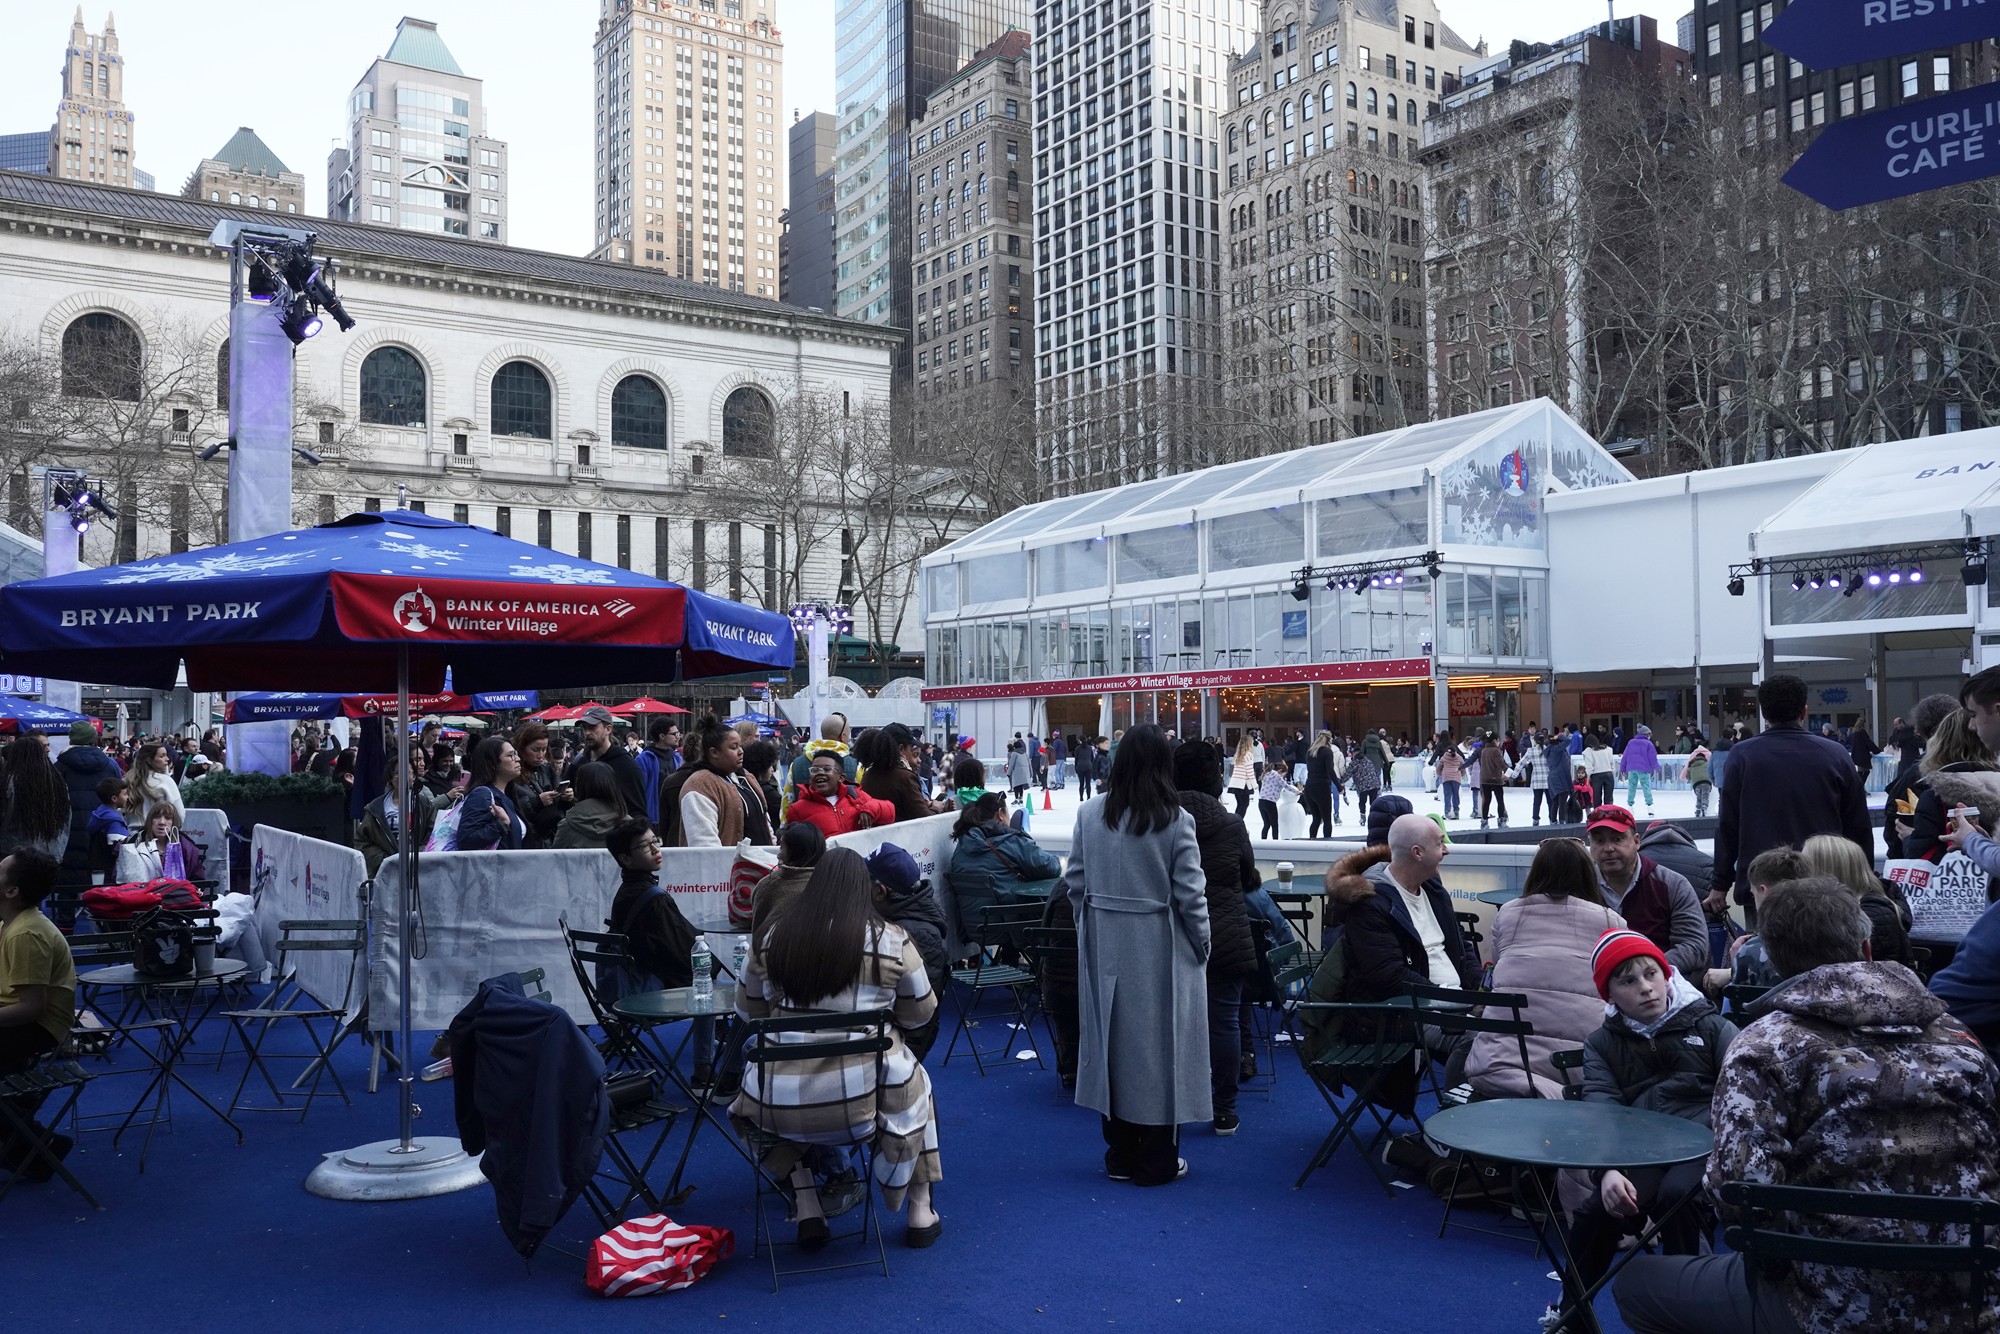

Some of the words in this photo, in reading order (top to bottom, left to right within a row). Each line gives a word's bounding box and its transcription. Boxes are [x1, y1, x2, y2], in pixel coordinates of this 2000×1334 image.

[1885, 100, 2000, 149] CURLI
[1887, 130, 1985, 178] CAFÉ
[1914, 460, 2000, 479] BAN
[60, 605, 174, 627] BRYANT
[187, 601, 262, 621] PARK
[446, 599, 494, 612] BANK
[498, 600, 521, 613] OF
[524, 601, 600, 616] AMERICA
[446, 616, 503, 631] Winter
[505, 617, 558, 636] Village
[706, 620, 746, 642] BRYANT
[747, 629, 778, 647] PARK
[1103, 681, 1127, 689] AMERICA
[1140, 676, 1166, 688] Winter
[1166, 675, 1193, 688] Village
[1202, 676, 1219, 686] Bryant
[1219, 675, 1231, 683] Park
[484, 695, 509, 703] BRYANT
[1455, 696, 1480, 707] EXIT
[253, 705, 292, 714] BRYANT
[1910, 876, 1926, 886] QLO
[1912, 870, 1928, 879] UNI
[1940, 876, 1986, 889] PARIS
[1935, 889, 1985, 898] MOSCOW
